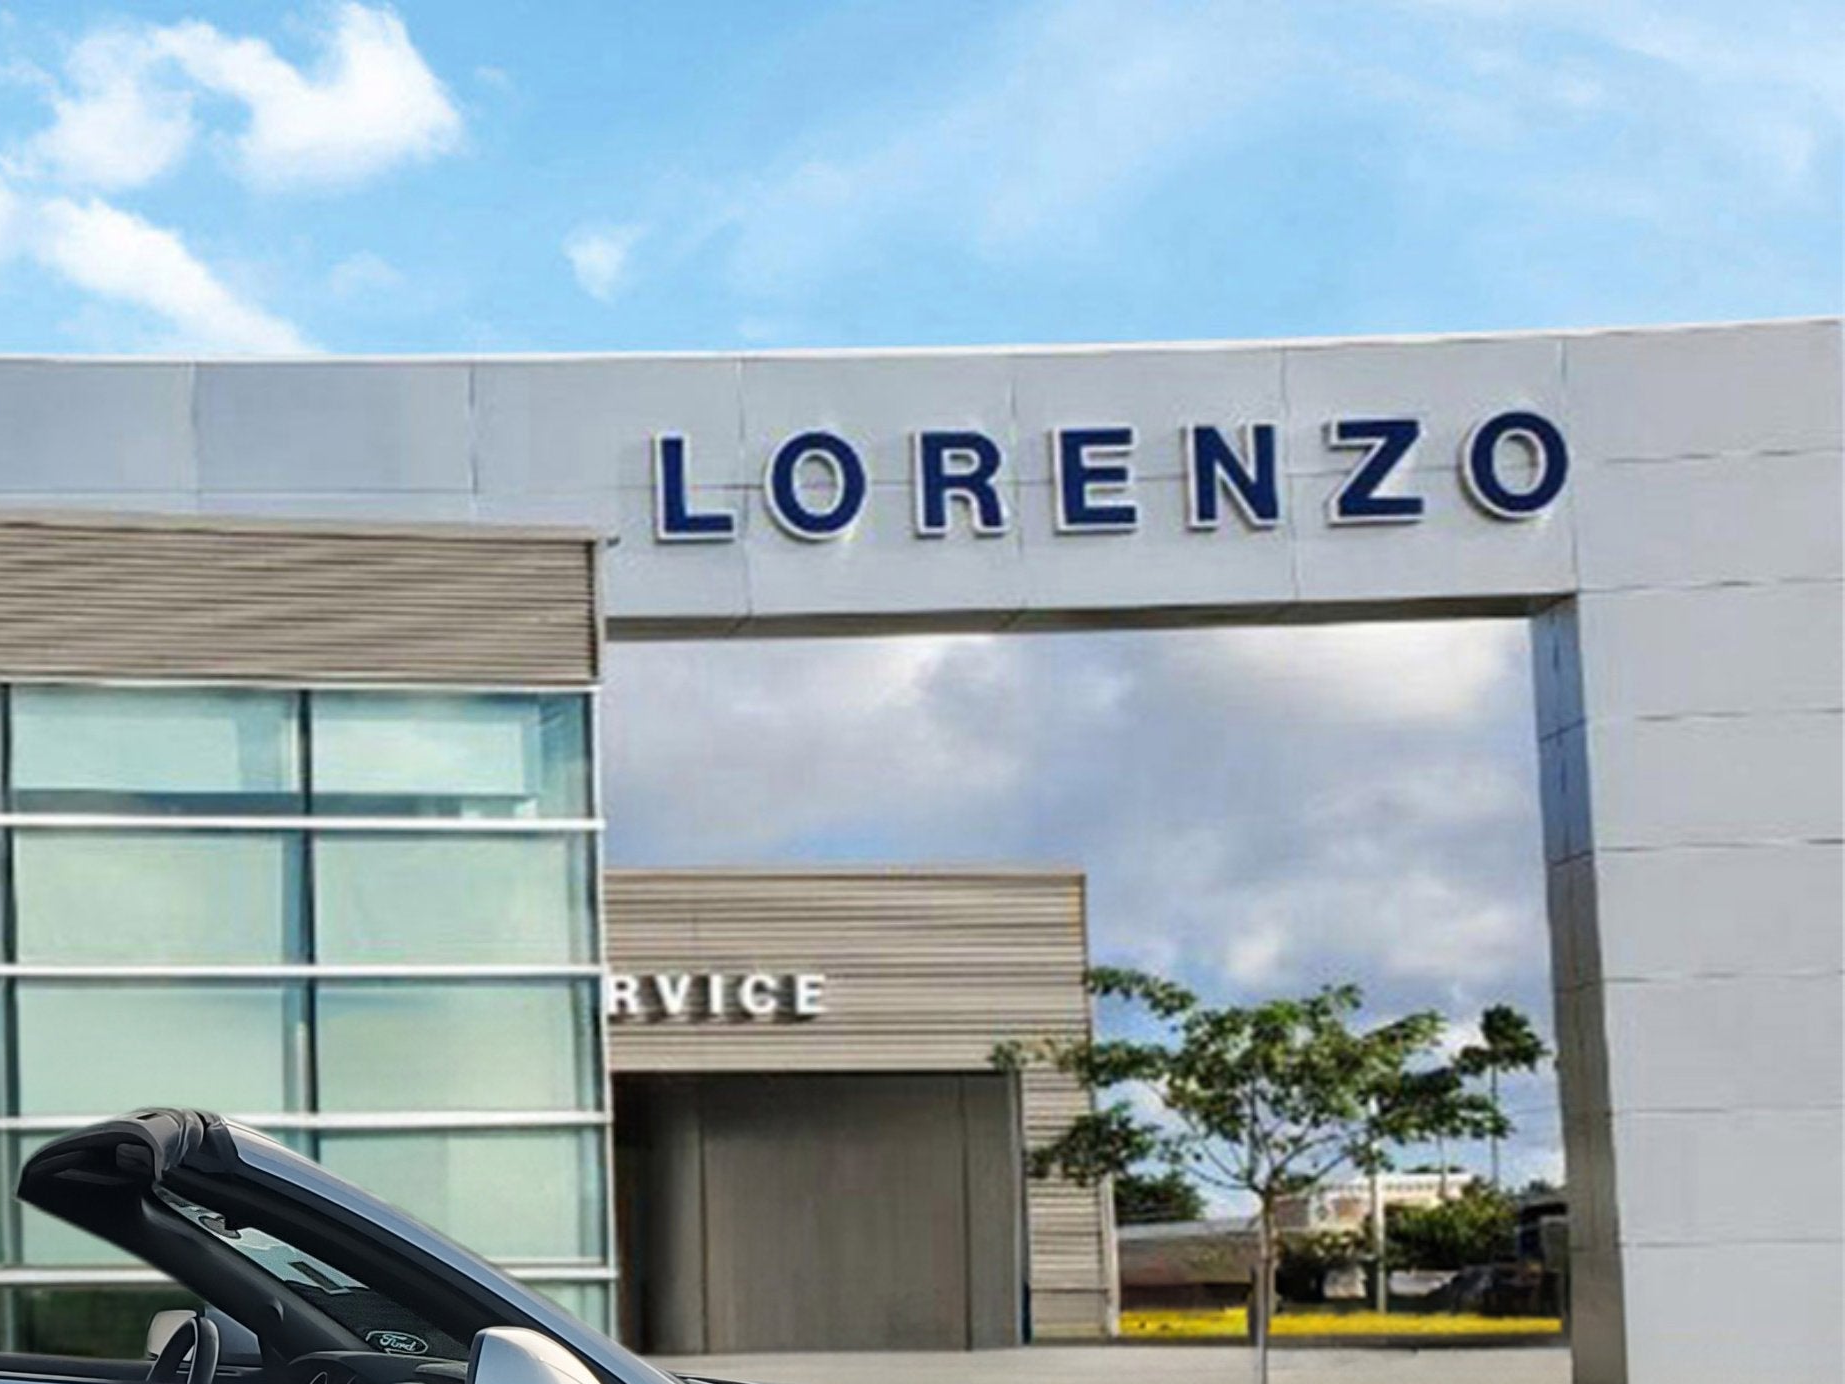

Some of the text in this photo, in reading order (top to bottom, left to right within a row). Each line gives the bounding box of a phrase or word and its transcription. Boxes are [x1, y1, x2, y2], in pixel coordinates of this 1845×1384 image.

[653, 410, 1570, 542] LORENZO
[607, 973, 828, 1014] RVICE
[379, 1333, 417, 1352] Ford
